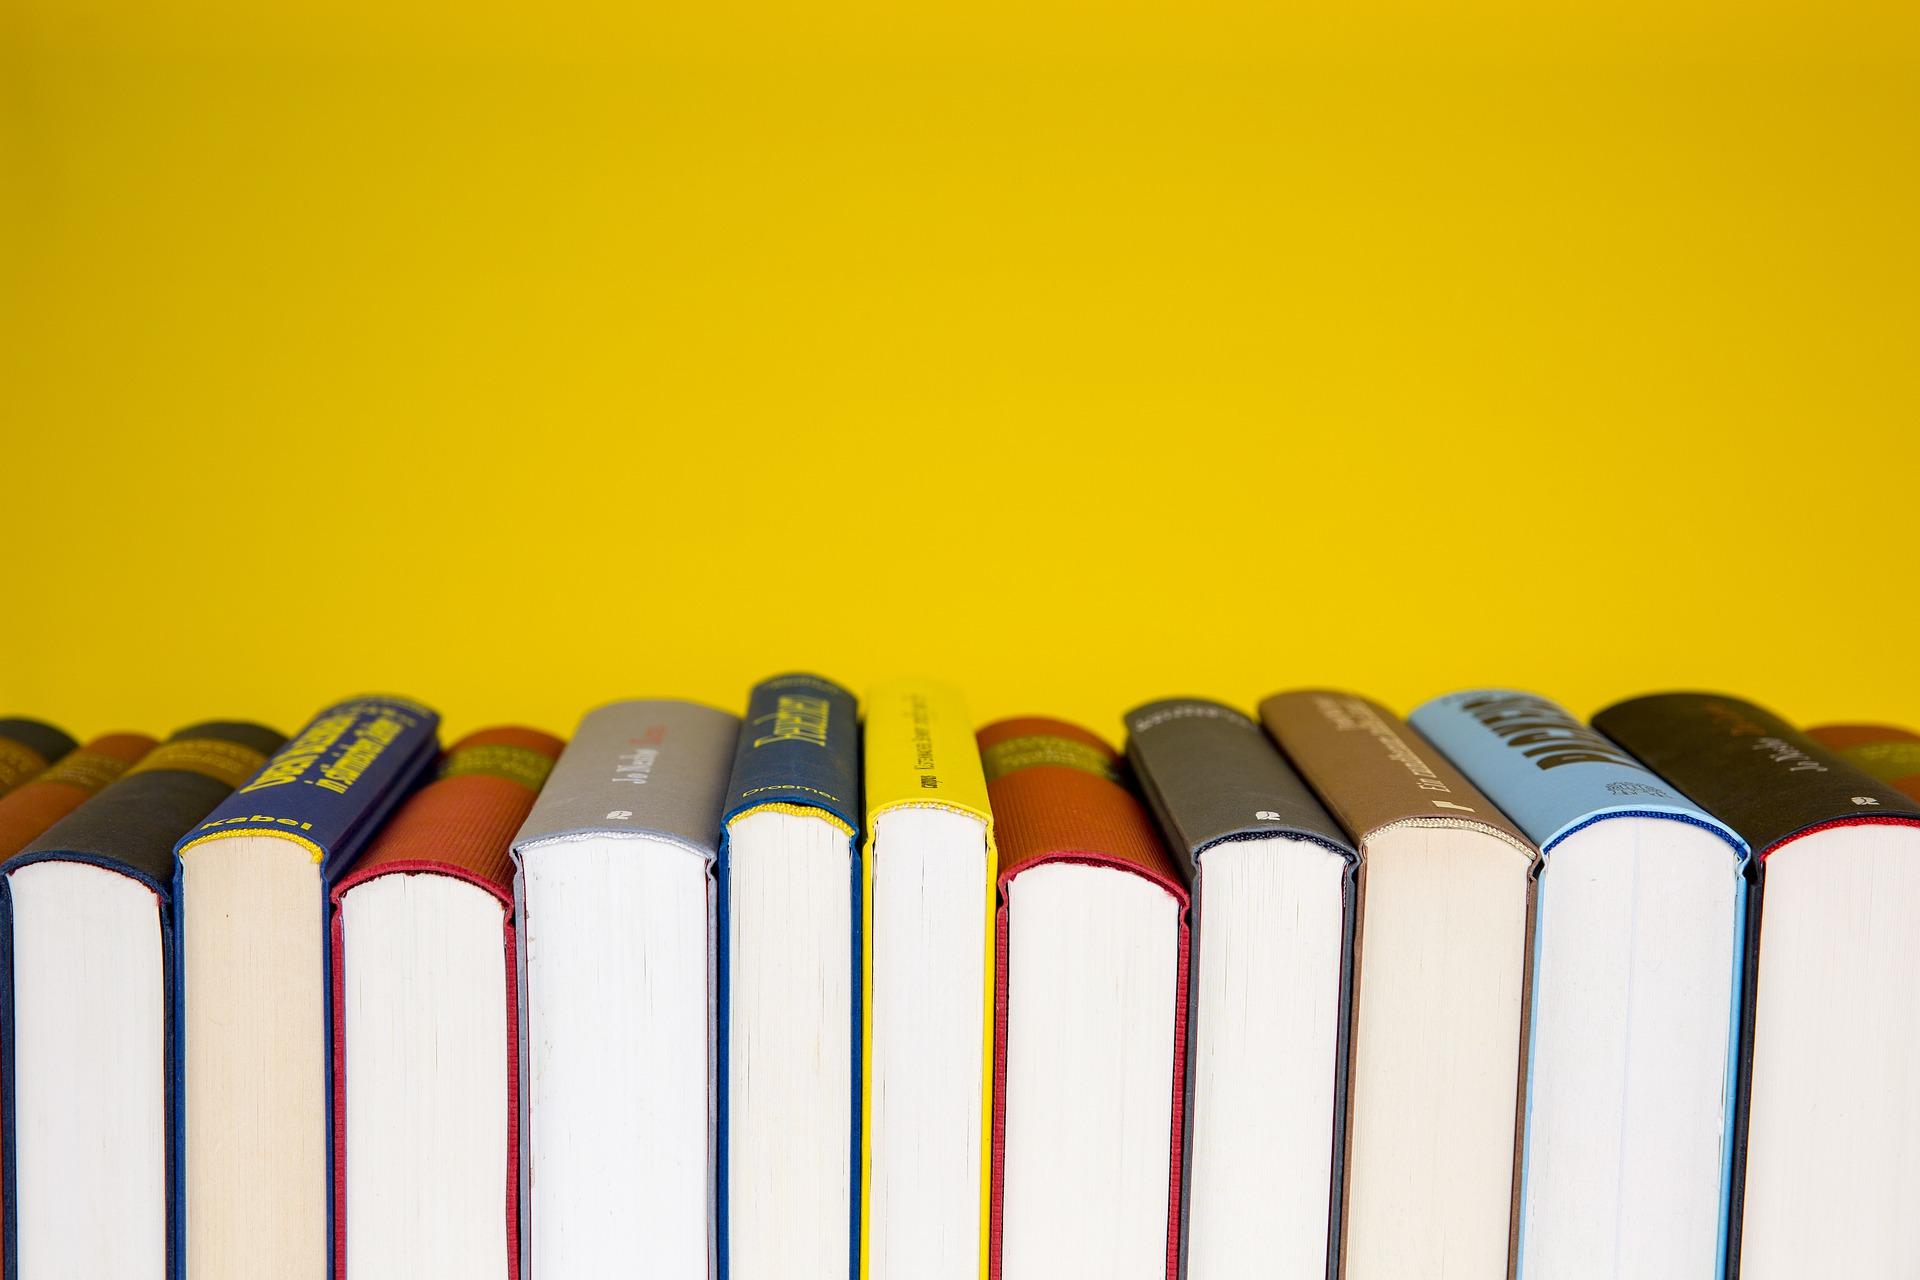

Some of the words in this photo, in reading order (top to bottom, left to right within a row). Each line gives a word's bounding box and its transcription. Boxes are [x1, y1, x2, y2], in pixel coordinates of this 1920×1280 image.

[304, 778, 349, 794] in
[611, 772, 648, 785] Jo
[1416, 777, 1452, 793] Ein
[742, 785, 841, 802] Droemer
[200, 815, 313, 831] Kabel
